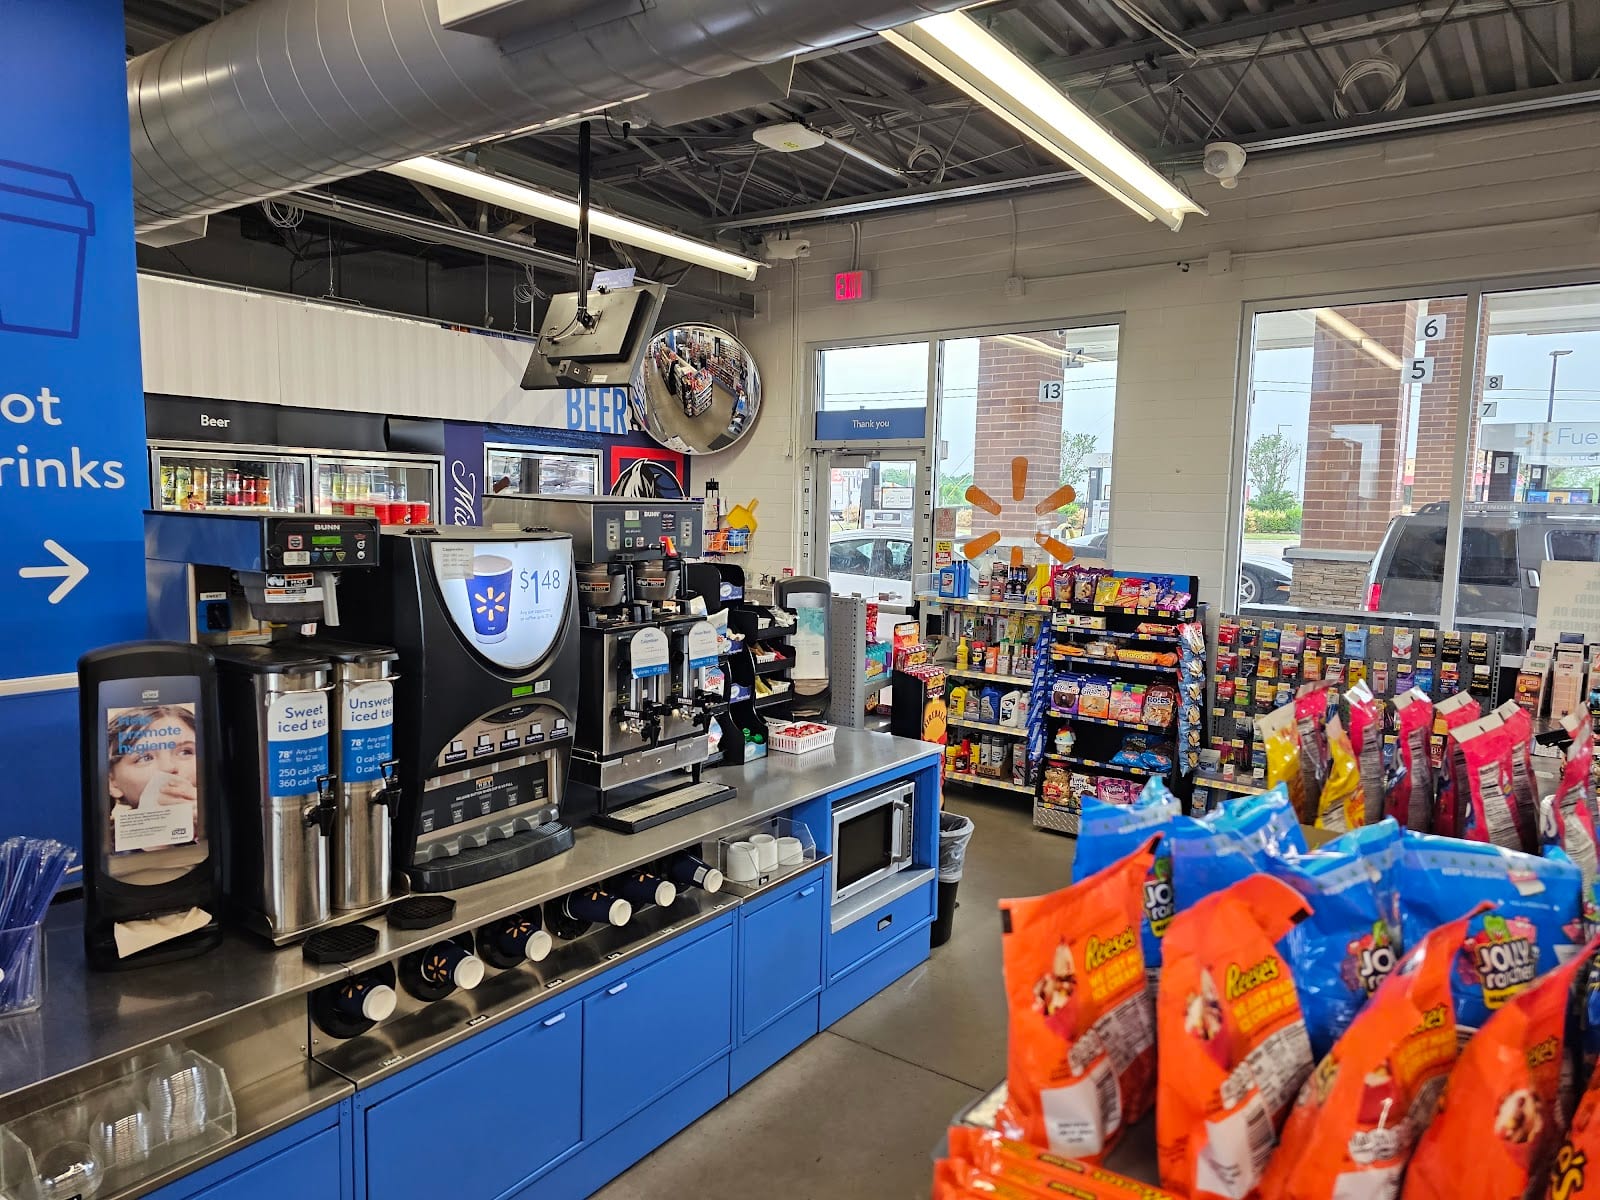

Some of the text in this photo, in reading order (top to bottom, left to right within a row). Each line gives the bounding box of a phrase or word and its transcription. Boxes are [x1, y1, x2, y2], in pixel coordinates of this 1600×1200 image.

[1424, 319, 1438, 337] 6
[1412, 360, 1425, 379] 5
[1489, 377, 1499, 388] 8
[1043, 383, 1061, 399] 13
[0, 387, 62, 426] ot
[566, 388, 627, 432] BEER
[1483, 403, 1492, 416] 7
[200, 414, 231, 428] Beer
[852, 419, 890, 431] Thank you
[1557, 427, 1599, 446] Fue
[0, 446, 126, 489] rinks
[1463, 503, 1518, 511] ATHFINDER
[313, 523, 341, 531] BUNN
[285, 704, 324, 718] Sweet
[351, 710, 378, 722] iced
[278, 718, 326, 733] iced tea
[118, 726, 182, 743] promote
[118, 739, 177, 754] hygiene
[356, 755, 362, 764] 0
[278, 768, 296, 777] 250
[356, 766, 362, 774] 0
[278, 779, 296, 788] 360
[1085, 927, 1136, 972] Reese's
[1479, 940, 1530, 973] JOLLY
[1225, 955, 1279, 1000] Reese's
